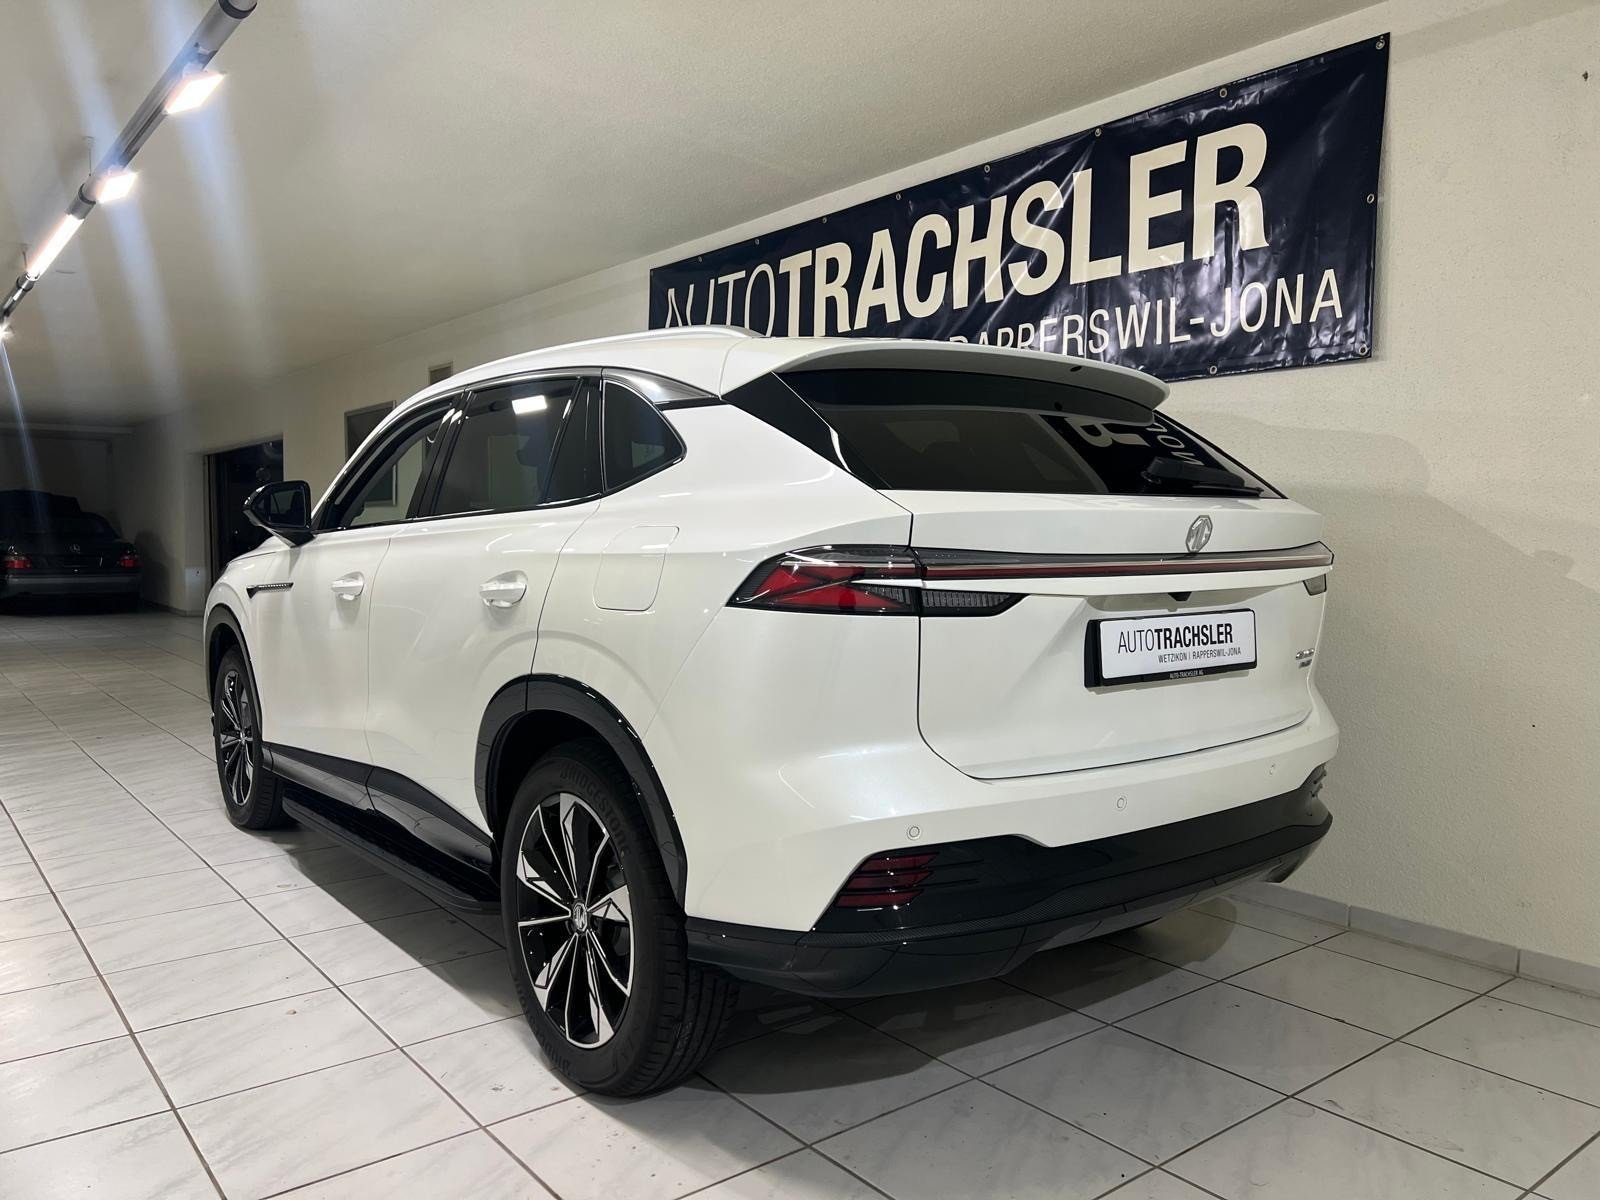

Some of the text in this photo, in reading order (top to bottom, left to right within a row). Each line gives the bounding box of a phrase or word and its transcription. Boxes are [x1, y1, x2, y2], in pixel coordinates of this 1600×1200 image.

[1118, 623, 1233, 654] AUTOTRACHSLER
[1158, 653, 1188, 663] WETZIKON
[1192, 647, 1241, 660] RAPPERSWIL-JONA
